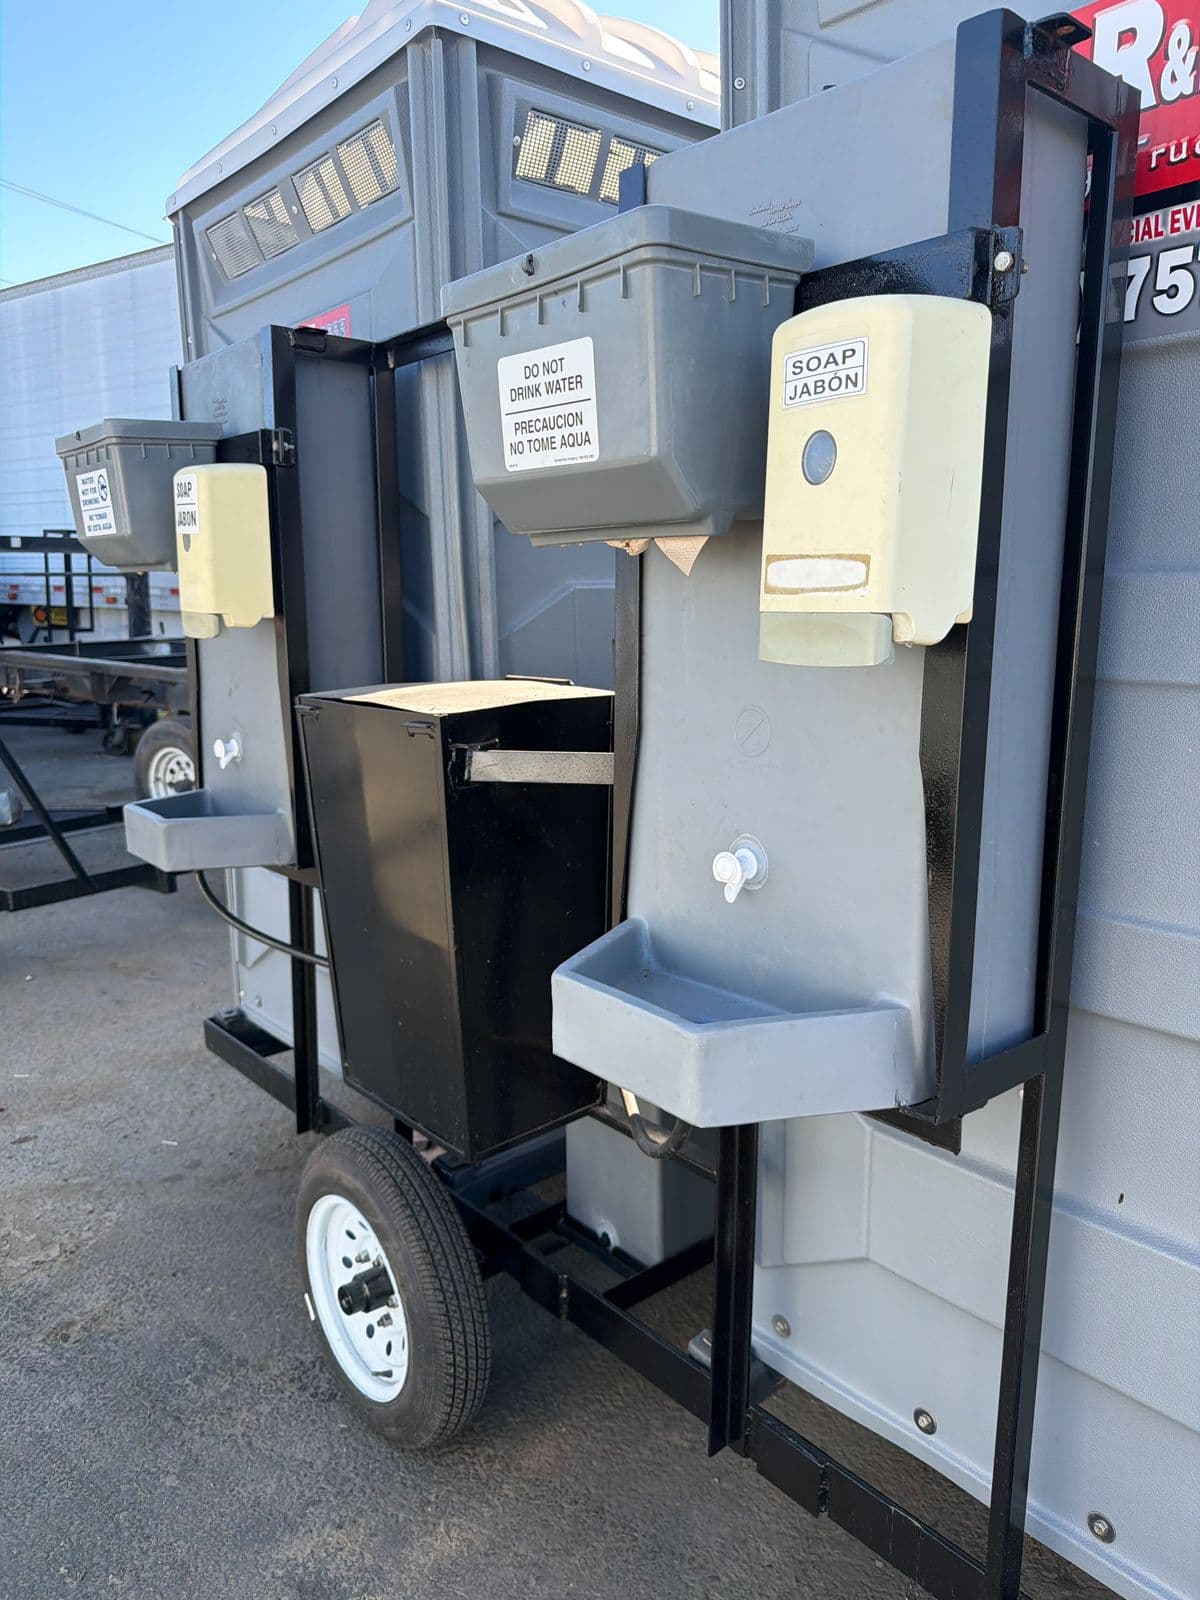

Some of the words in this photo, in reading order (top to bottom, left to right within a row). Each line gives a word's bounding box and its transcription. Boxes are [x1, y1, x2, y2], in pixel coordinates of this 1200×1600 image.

[1129, 214, 1164, 243] IAL
[1123, 244, 1200, 322] 75
[523, 363, 540, 380] DO
[542, 357, 565, 376] NOT
[791, 348, 857, 376] SOAP
[509, 382, 543, 403] DRINK
[544, 374, 584, 396] WATER
[788, 371, 859, 401] JABÓN
[513, 410, 584, 436] PRECAUCION
[509, 441, 525, 456] NO
[526, 435, 557, 454] TOME
[559, 430, 592, 450] AQUA
[176, 481, 193, 499] SOAP
